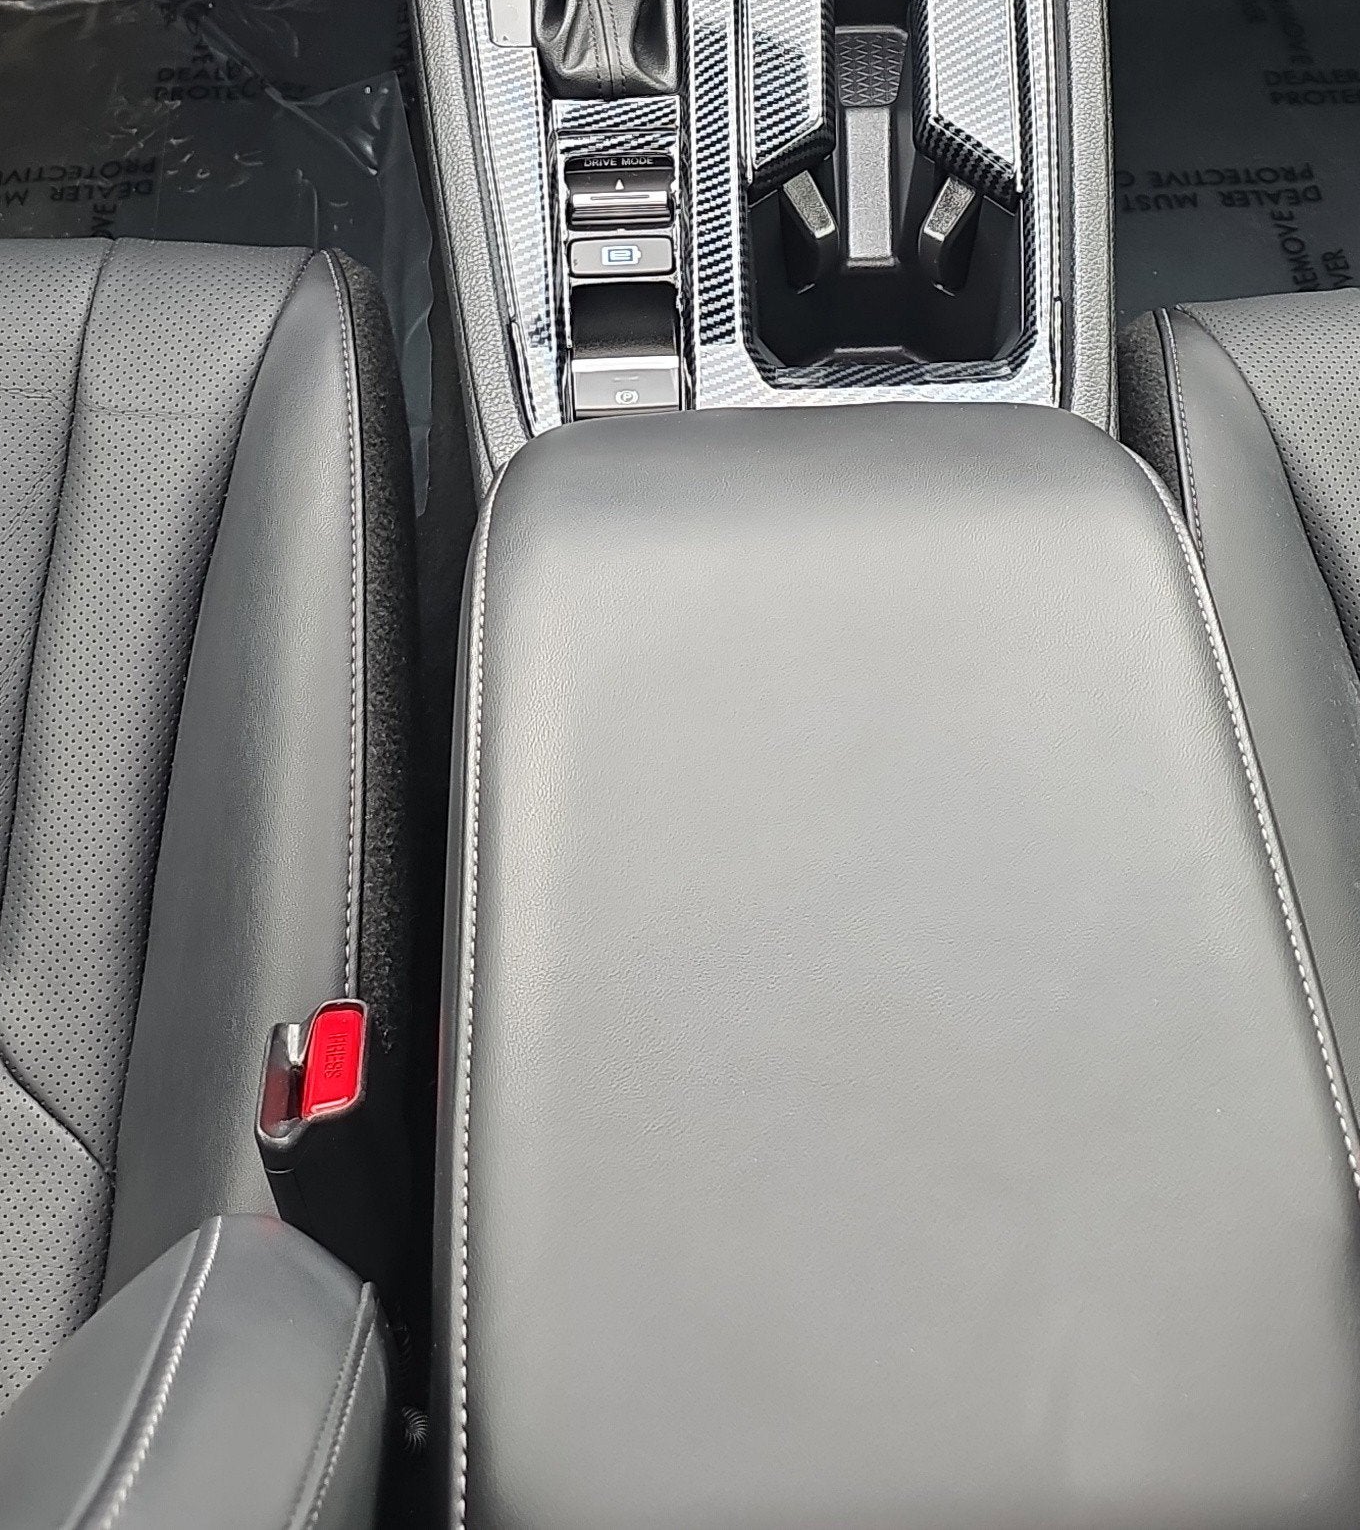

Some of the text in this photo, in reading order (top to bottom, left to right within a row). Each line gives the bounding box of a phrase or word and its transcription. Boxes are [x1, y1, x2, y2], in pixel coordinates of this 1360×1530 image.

[583, 156, 655, 167] DRIVE MODE
[1149, 161, 1316, 189] PROTECTIVE
[48, 178, 155, 203] DEALER
[1120, 183, 1324, 213] DEALER MUST
[323, 1032, 349, 1080] PRESS
